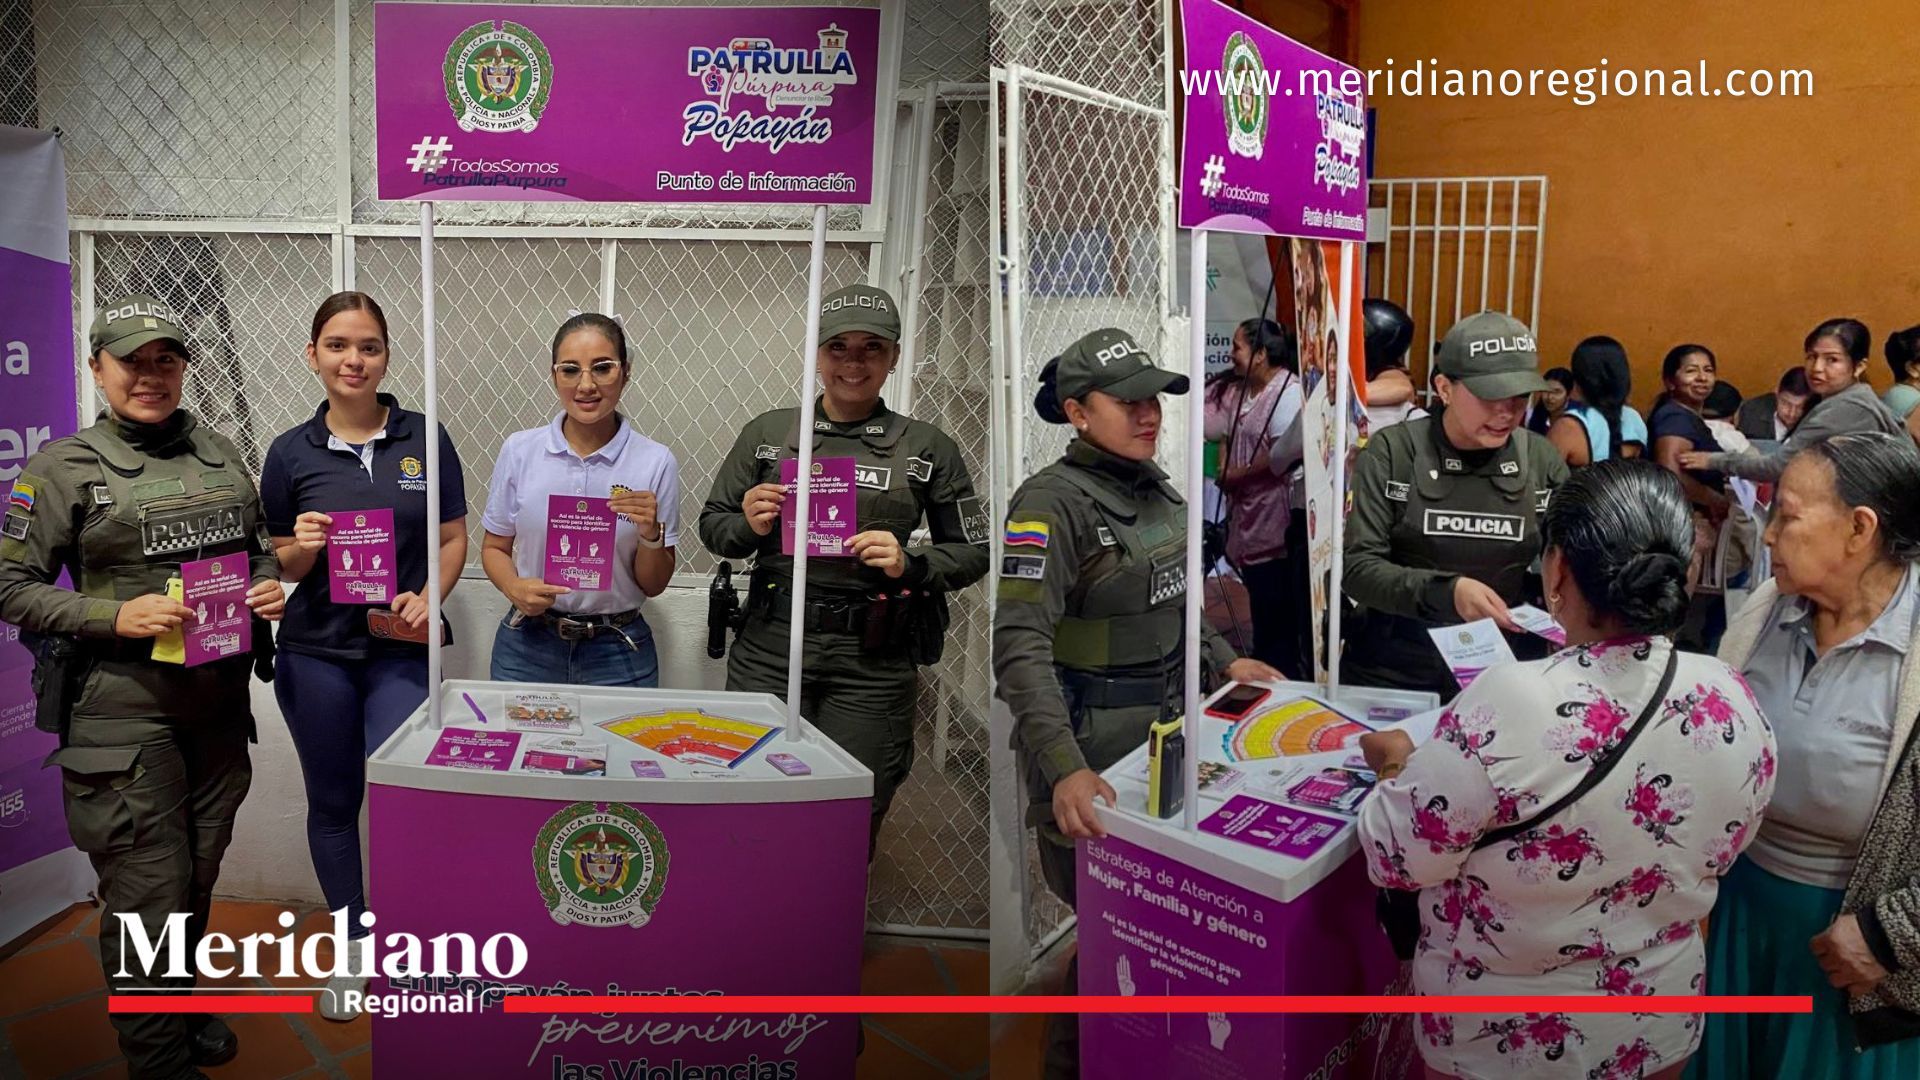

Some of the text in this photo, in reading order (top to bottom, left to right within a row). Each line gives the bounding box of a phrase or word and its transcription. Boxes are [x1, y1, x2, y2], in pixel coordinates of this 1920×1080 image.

[514, 38, 539, 82] COLOMBIA
[690, 50, 854, 75] PATRULLA
[723, 64, 832, 109] Púrpura
[498, 92, 536, 118] NACIONAL
[498, 117, 526, 129] PATRIA
[685, 107, 829, 150] Popayán
[657, 170, 856, 192] Punto de información
[105, 302, 179, 329] POLICÍA
[821, 294, 888, 317] POLICÍA
[1436, 515, 1513, 535] POLICIA
[551, 815, 652, 873] REPUBLICA DE COLOMBIA
[556, 881, 647, 912] POLICIA NACIONAL
[1087, 840, 1264, 924] Estrategia de Atención a
[600, 910, 635, 924] PATRIA
[1087, 861, 1268, 949] Mujer, Familia y género
[1116, 918, 1127, 929] es
[1128, 922, 1137, 934] la
[1138, 928, 1164, 945] señal
[1165, 939, 1178, 951] de
[1180, 945, 1217, 967] socorro
[1218, 962, 1241, 979] para
[1159, 948, 1168, 960] la
[1170, 952, 1215, 979] violencia
[1216, 974, 1229, 986] de
[528, 1012, 828, 1068] prevenimos
[551, 1055, 798, 1080] las Violencias
